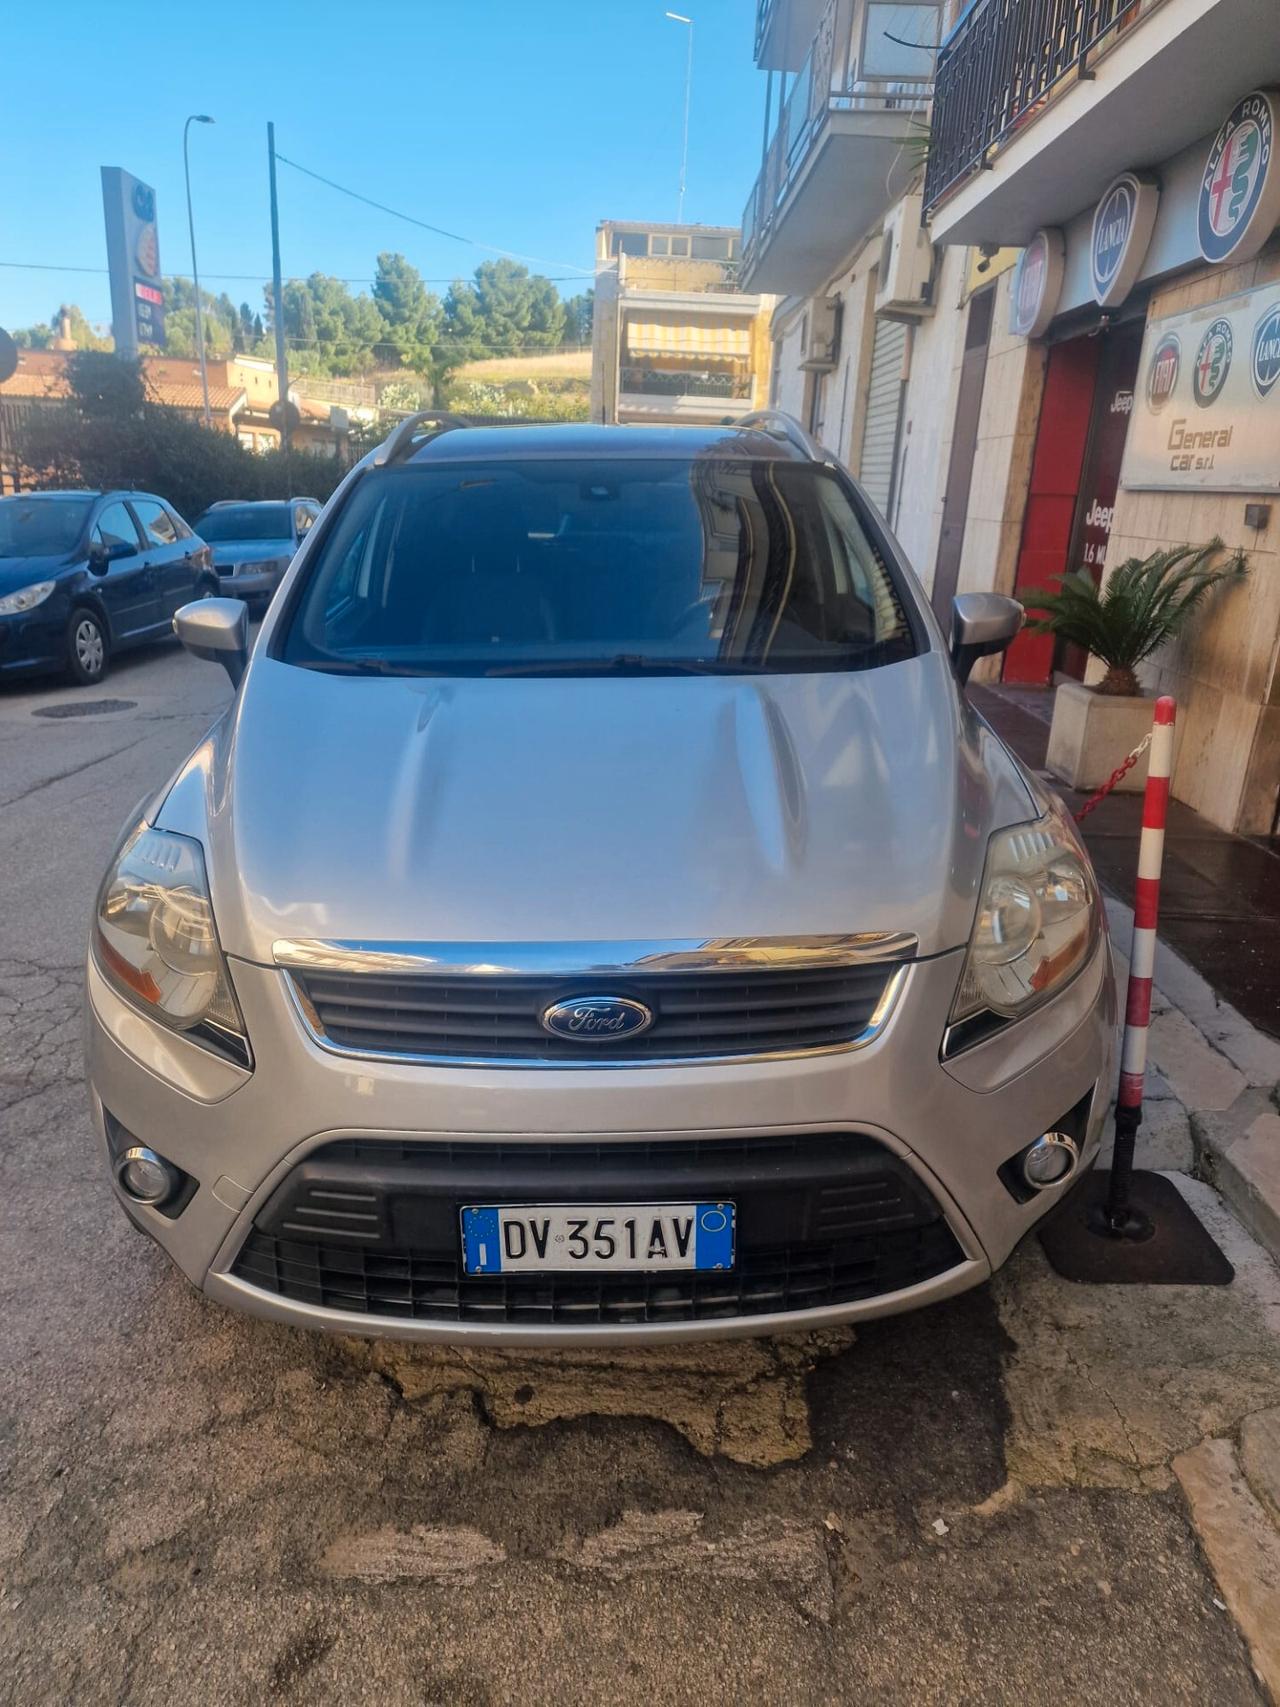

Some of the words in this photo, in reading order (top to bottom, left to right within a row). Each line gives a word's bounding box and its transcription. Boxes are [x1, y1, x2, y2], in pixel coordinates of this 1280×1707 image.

[1204, 121, 1235, 191] ALFA
[1242, 99, 1271, 165] ROMEO
[1098, 215, 1126, 254] LANCIA
[1153, 357, 1176, 394] FIAT
[1110, 390, 1133, 415] Jeep
[1167, 419, 1233, 450] General
[1170, 454, 1195, 471] car
[568, 1007, 625, 1031] Ford
